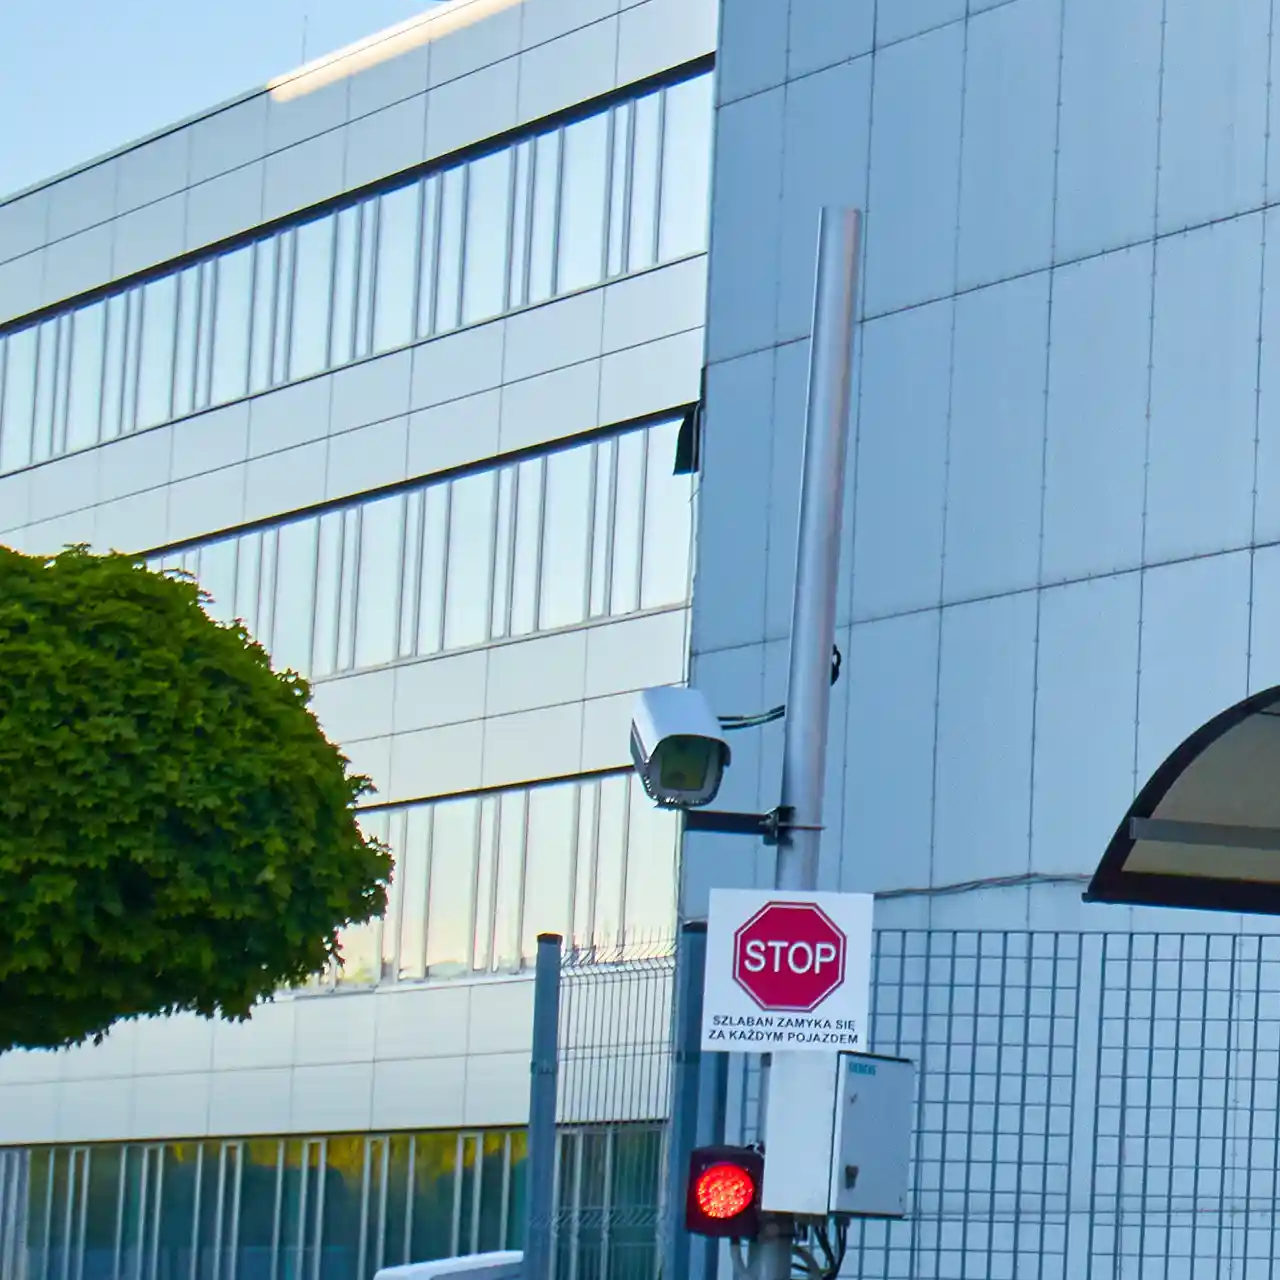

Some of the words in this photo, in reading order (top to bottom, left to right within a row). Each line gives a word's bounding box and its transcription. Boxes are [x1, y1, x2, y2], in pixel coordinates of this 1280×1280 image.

[744, 939, 836, 974] STOP
[713, 1015, 773, 1028] SZLABAN
[777, 1017, 832, 1030] ZAMYKA
[835, 1019, 856, 1032] SIĘ
[708, 1029, 726, 1040] ZA
[729, 1028, 784, 1042] KAŻDYM
[787, 1031, 858, 1044] POJAZDEM
